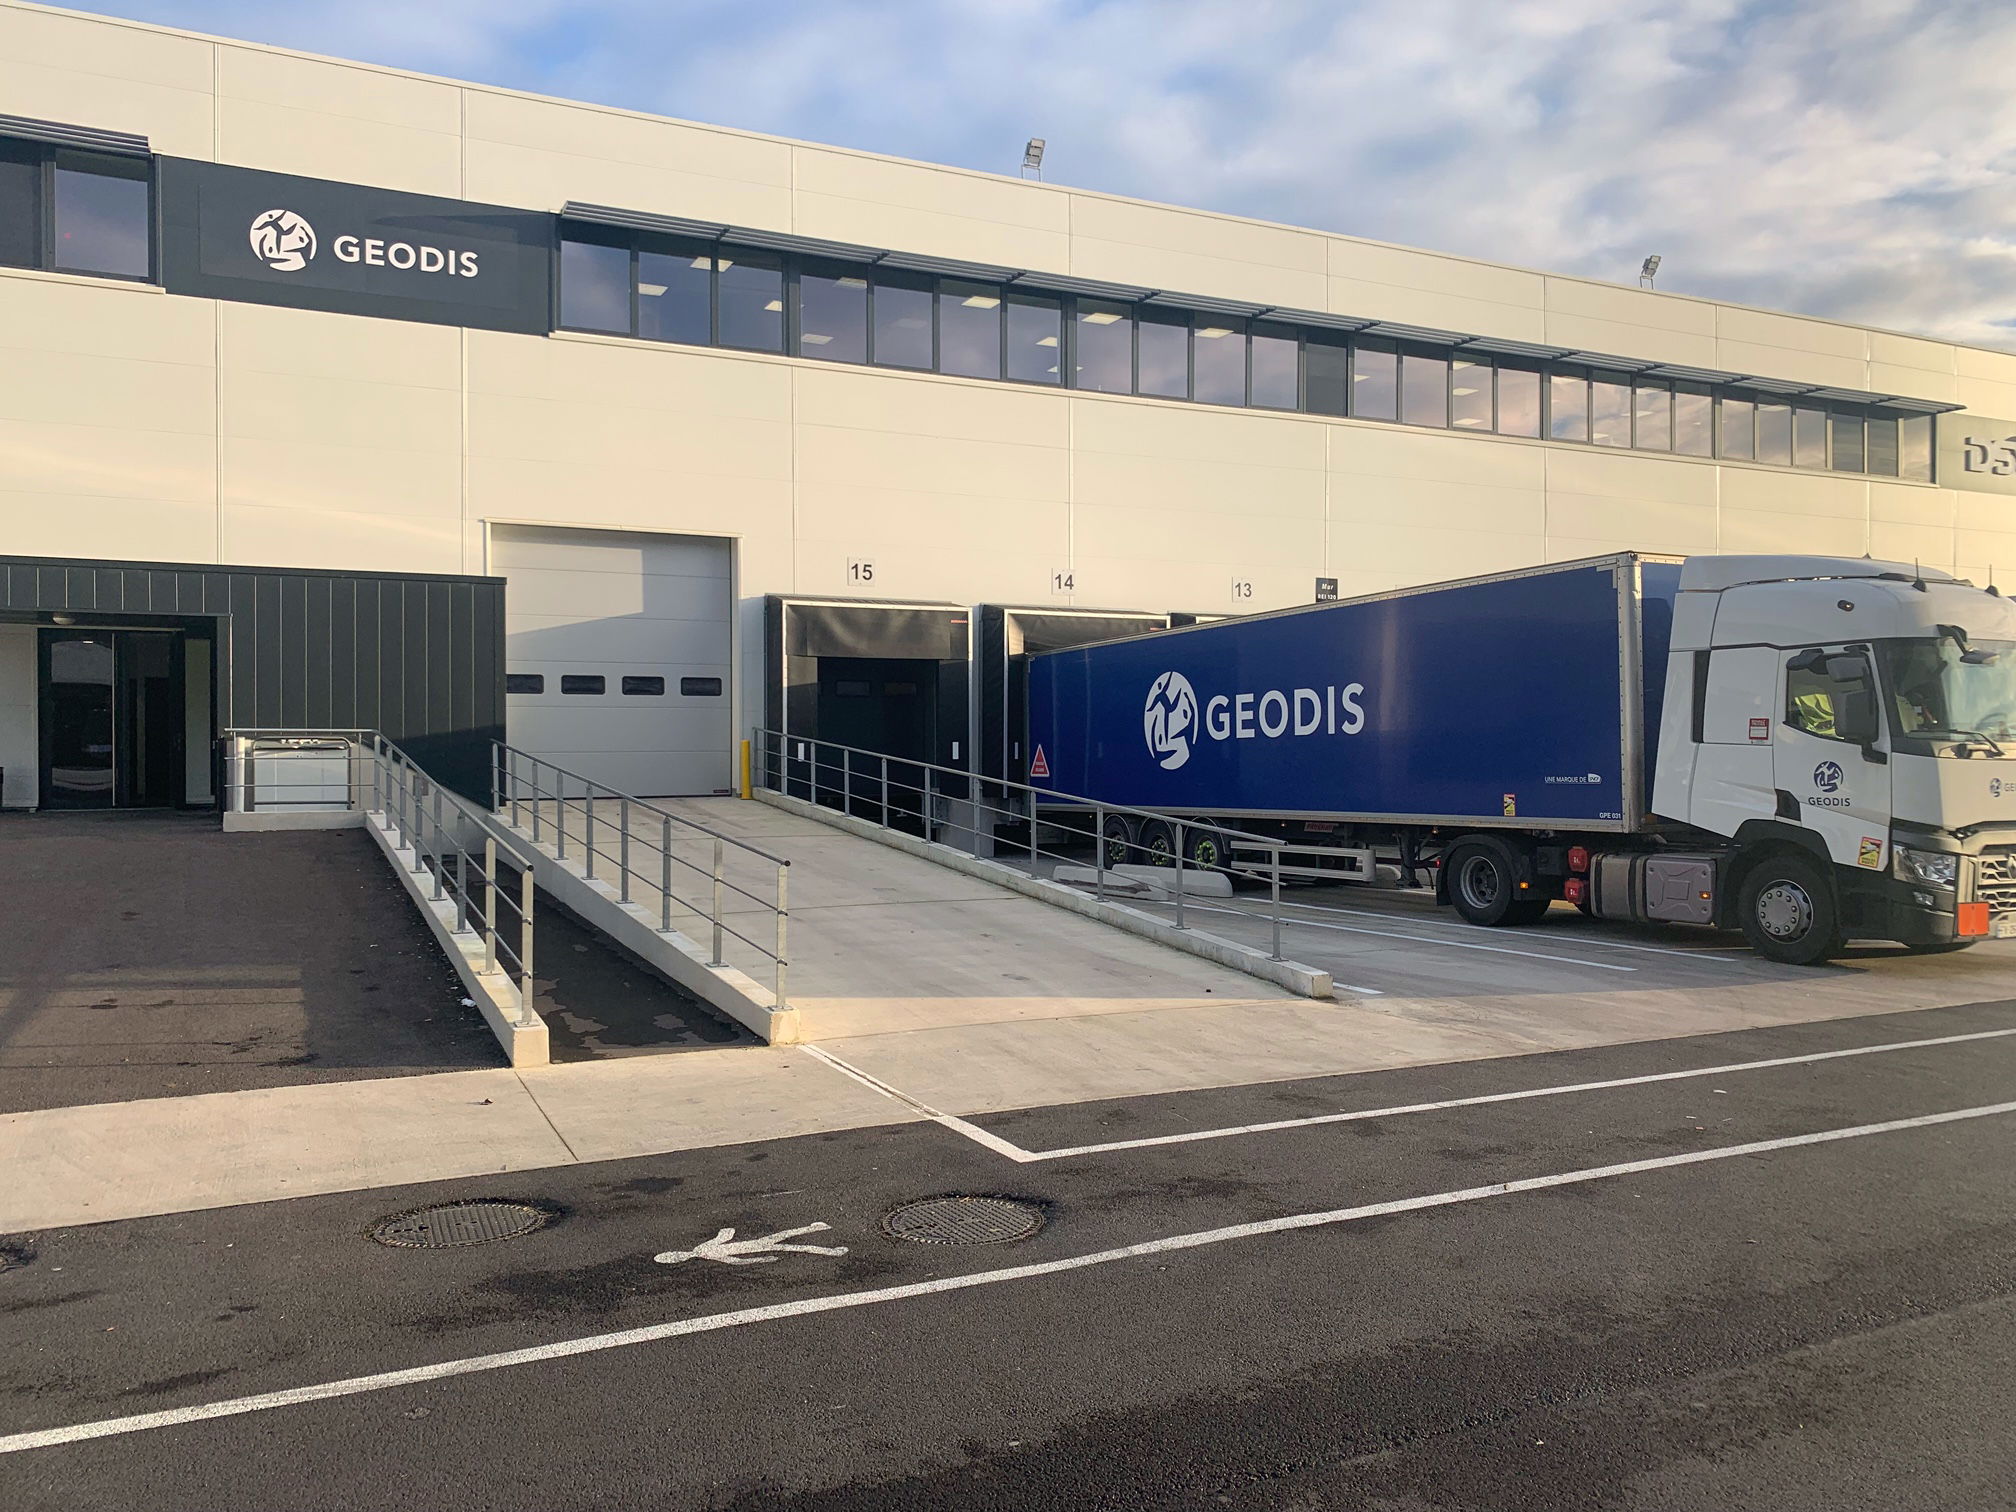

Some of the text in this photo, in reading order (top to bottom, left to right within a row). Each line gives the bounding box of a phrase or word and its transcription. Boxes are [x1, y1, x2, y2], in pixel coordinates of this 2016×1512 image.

[333, 235, 479, 278] GEODIS
[850, 563, 873, 581] 15
[1054, 573, 1075, 591] 14
[1234, 582, 1253, 598] 13
[1206, 682, 1365, 741] GEODIS
[2004, 783, 2016, 792] GE
[1807, 796, 1851, 807] GEODIS
